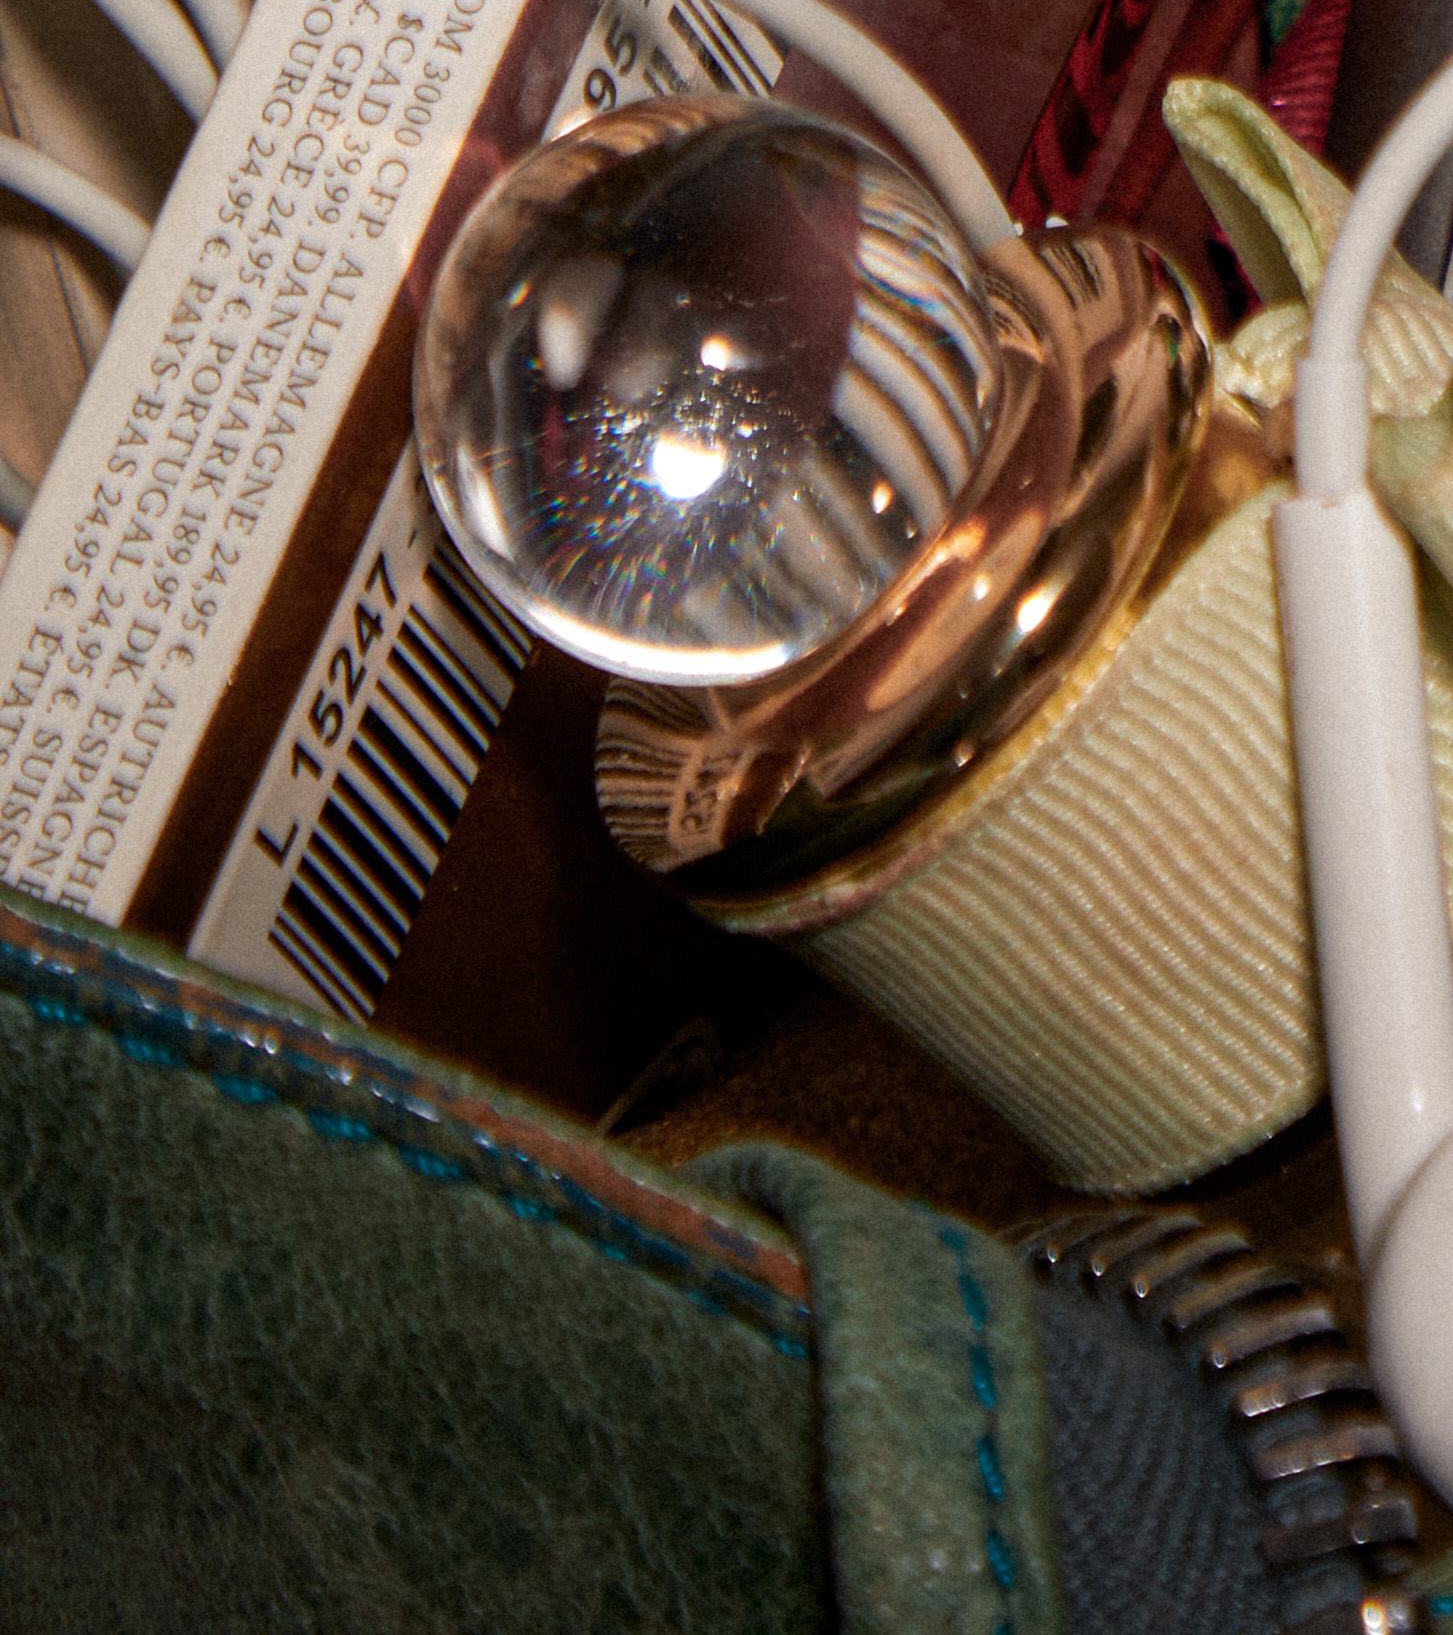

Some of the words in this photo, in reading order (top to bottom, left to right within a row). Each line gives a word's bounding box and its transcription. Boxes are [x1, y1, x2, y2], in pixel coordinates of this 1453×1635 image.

[278, 42, 366, 188] GRÈCE
[355, 12, 424, 128] $CAD
[394, 59, 451, 148] 3000
[217, 136, 277, 228] 24,95
[348, 157, 410, 242] CFP.
[238, 193, 296, 292] 24,95
[106, 274, 218, 478] PAYS-BAS
[189, 241, 326, 501] DANEMARK
[223, 251, 366, 539] ALLEMAGNE
[108, 336, 240, 576] PORTUGAL
[62, 482, 124, 582] 24,95
[140, 502, 207, 617] 189,95
[65, 581, 125, 680] 24,95
[180, 541, 241, 641] 24,95
[253, 822, 299, 869] L
[291, 551, 398, 782] 15247
